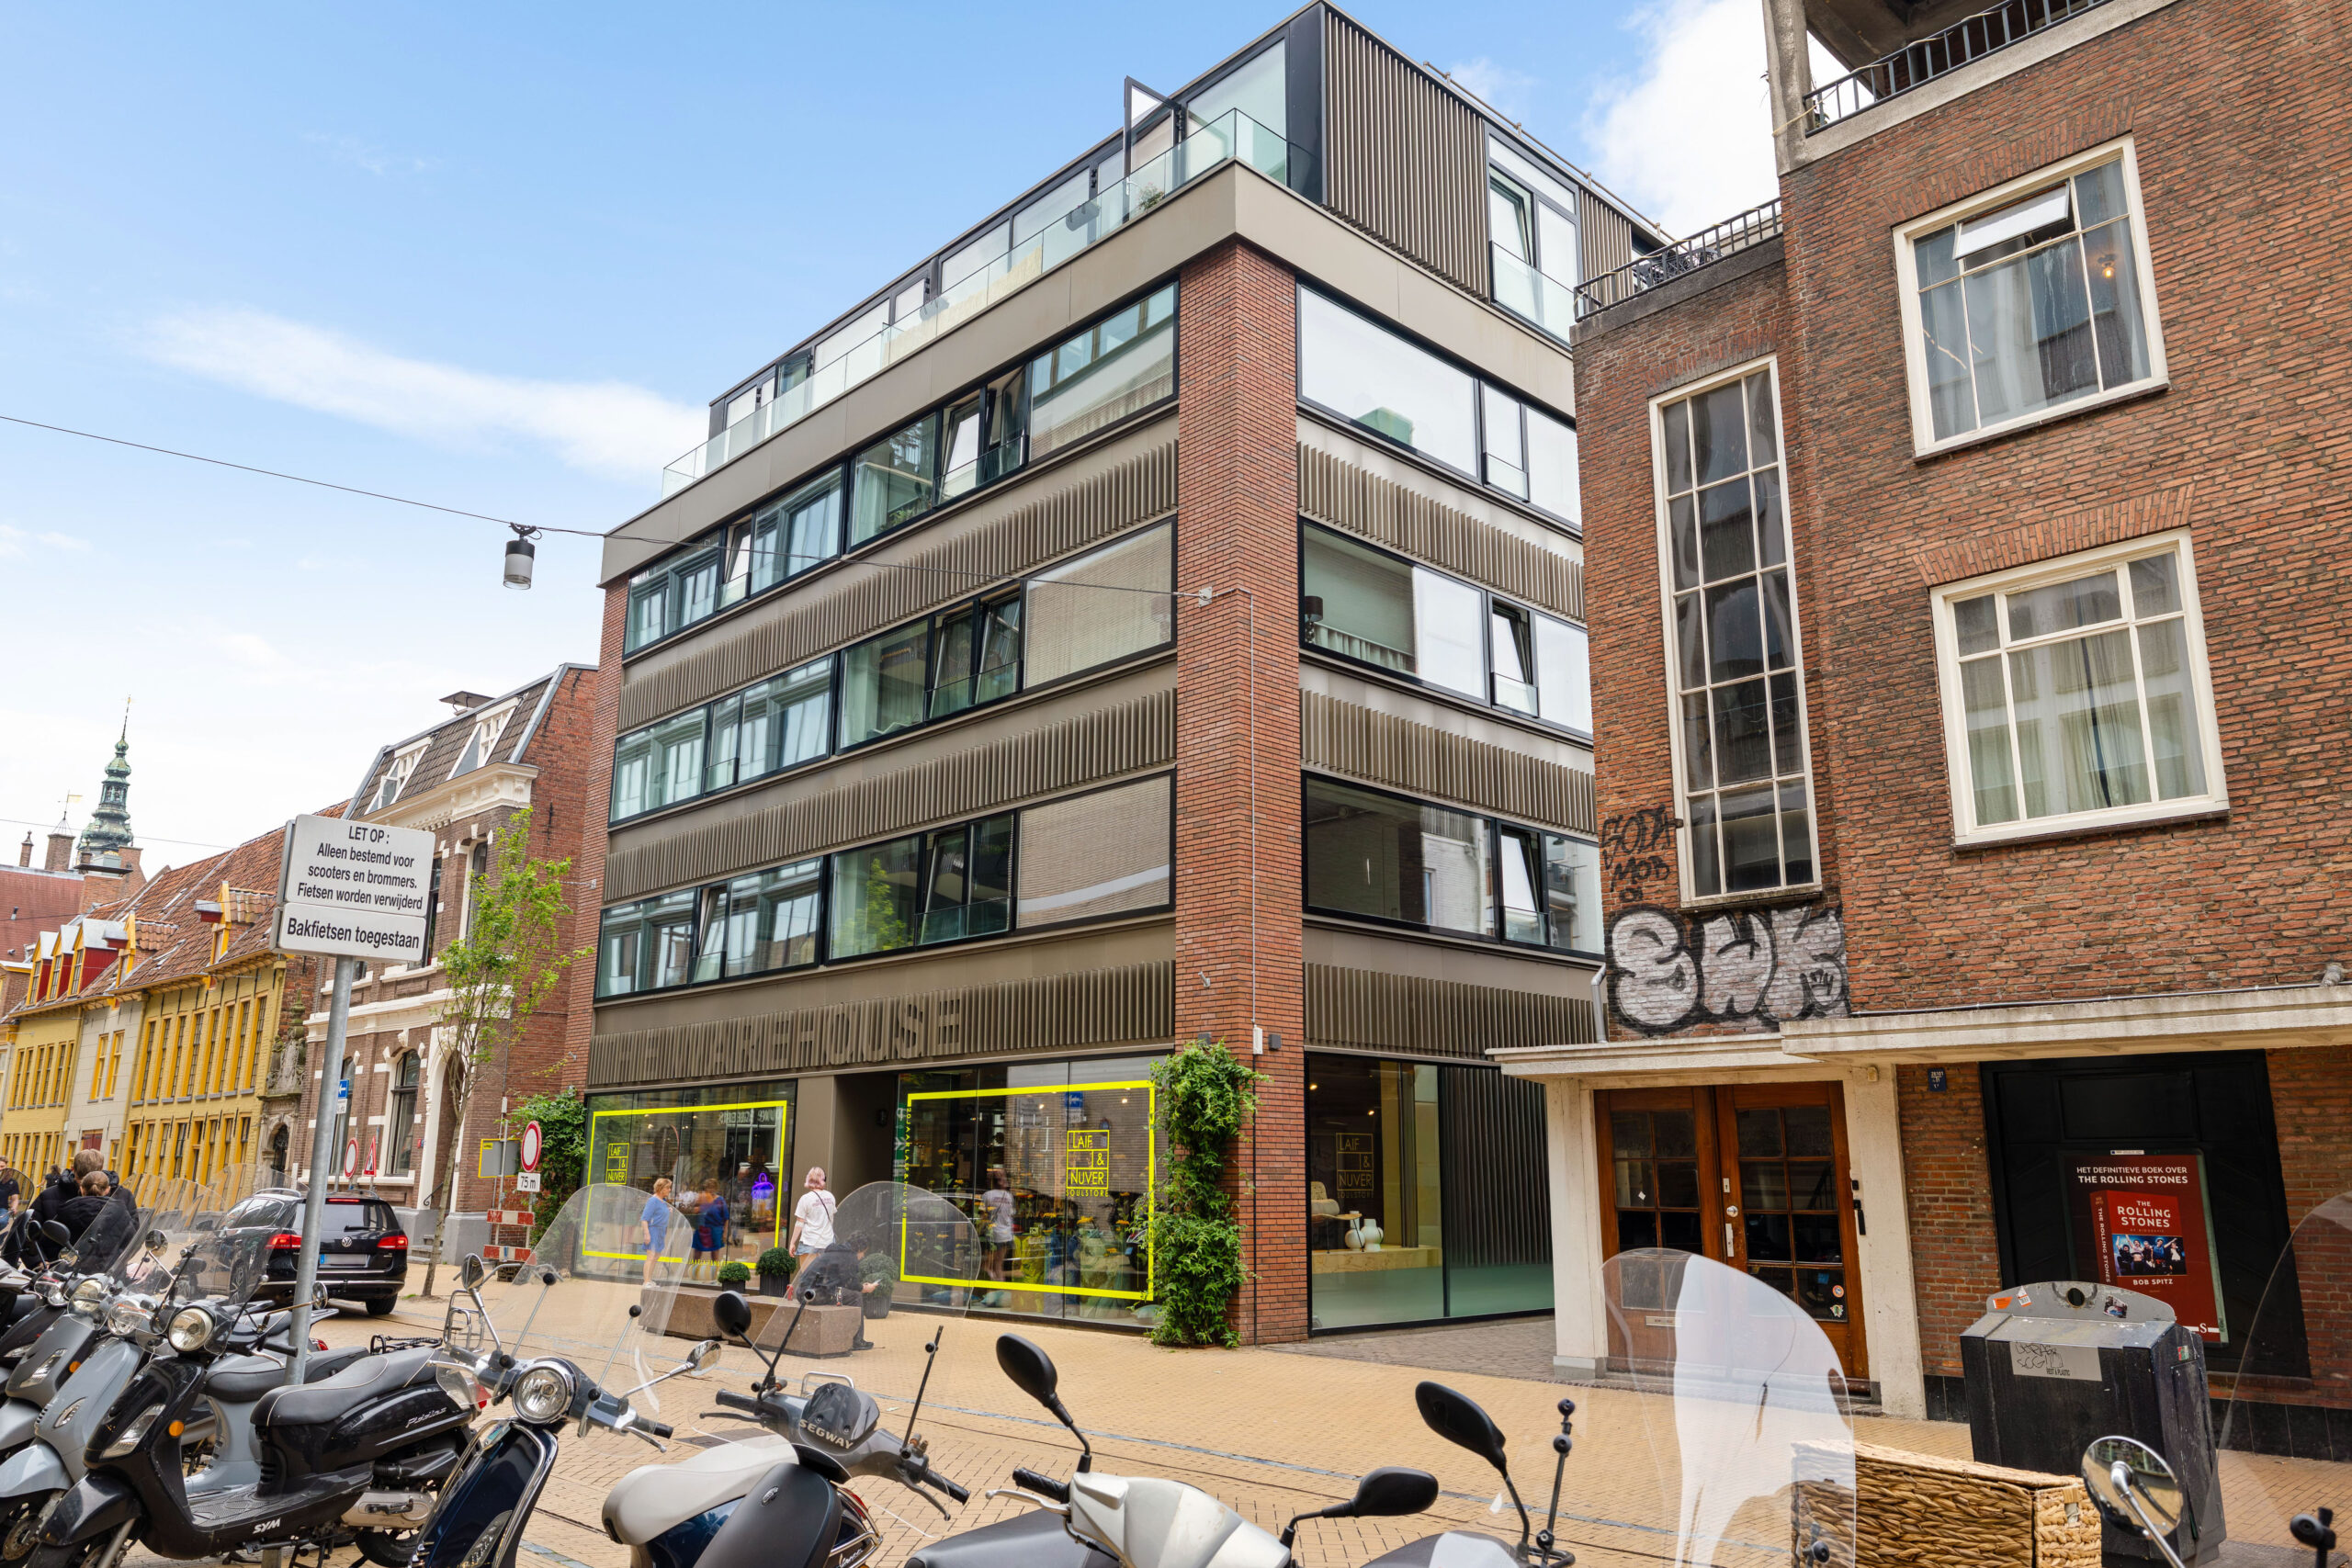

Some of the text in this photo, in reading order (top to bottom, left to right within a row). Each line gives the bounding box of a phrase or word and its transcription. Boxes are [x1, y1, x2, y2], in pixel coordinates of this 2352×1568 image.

[348, 826, 368, 840] LET
[317, 842, 414, 868] Alleen bestemd voor
[308, 865, 417, 889] scooters en brommers.
[298, 882, 423, 911] Fietsen worden verwijderd
[287, 918, 420, 949] Bakfietsen toegestaan
[1072, 1132, 1093, 1148] LAIF
[1340, 1135, 1360, 1151] LAIF
[1096, 1153, 1104, 1166] &
[1363, 1156, 1370, 1168] &
[521, 1177, 537, 1190] 75 m
[607, 1171, 626, 1181] NUVER
[1070, 1168, 1104, 1185] NUVER
[1339, 1171, 1372, 1187] NUVER
[2100, 1176, 2144, 1184] ROLLING
[2147, 1176, 2188, 1184] STONES
[2117, 1206, 2171, 1218] ROLLING
[2120, 1216, 2170, 1228] STONES
[2099, 1223, 2108, 1253] ROLLING
[2103, 1255, 2111, 1283] STONES
[2199, 1323, 2208, 1334] S
[799, 1418, 854, 1450] SEGWAY
[253, 1517, 281, 1534] SYM
